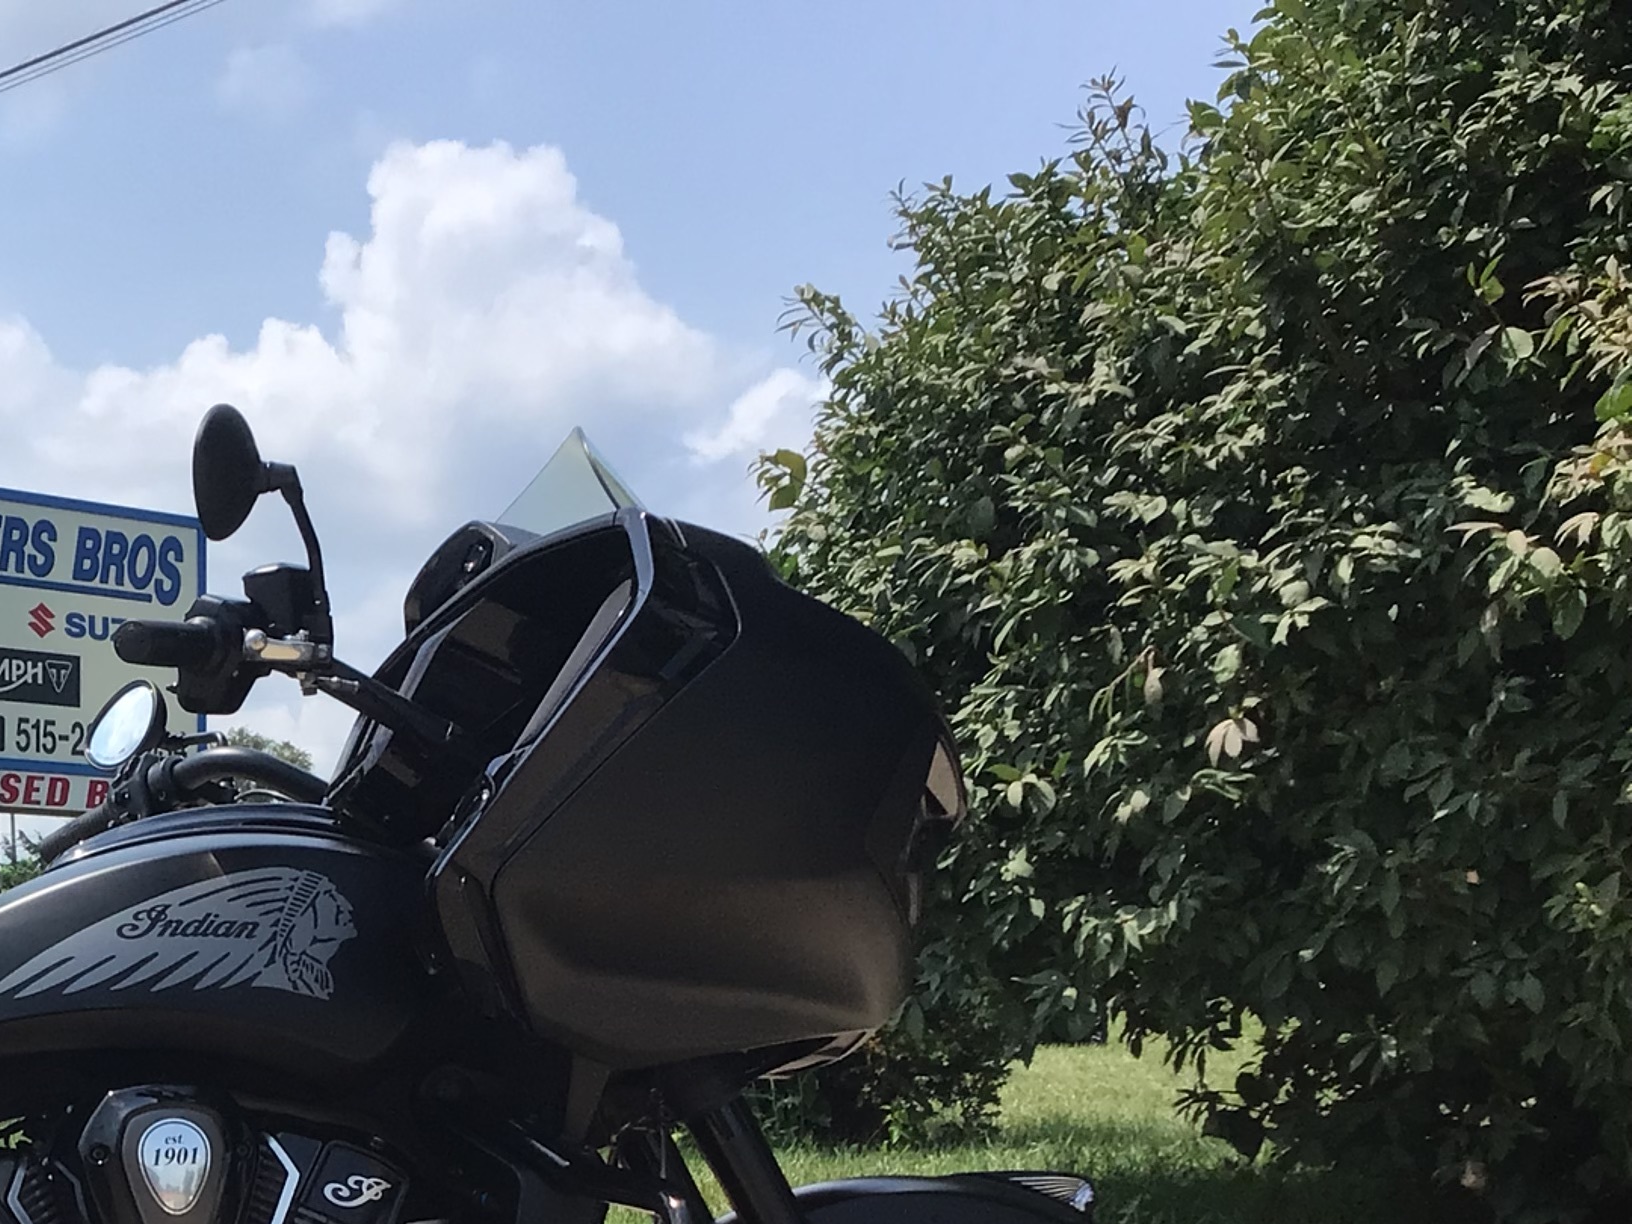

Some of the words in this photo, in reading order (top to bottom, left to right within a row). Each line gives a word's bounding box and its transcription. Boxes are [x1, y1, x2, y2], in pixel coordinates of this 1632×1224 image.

[72, 526, 184, 606] BROS
[116, 904, 260, 940] Indian
[153, 1147, 198, 1166] 1901
